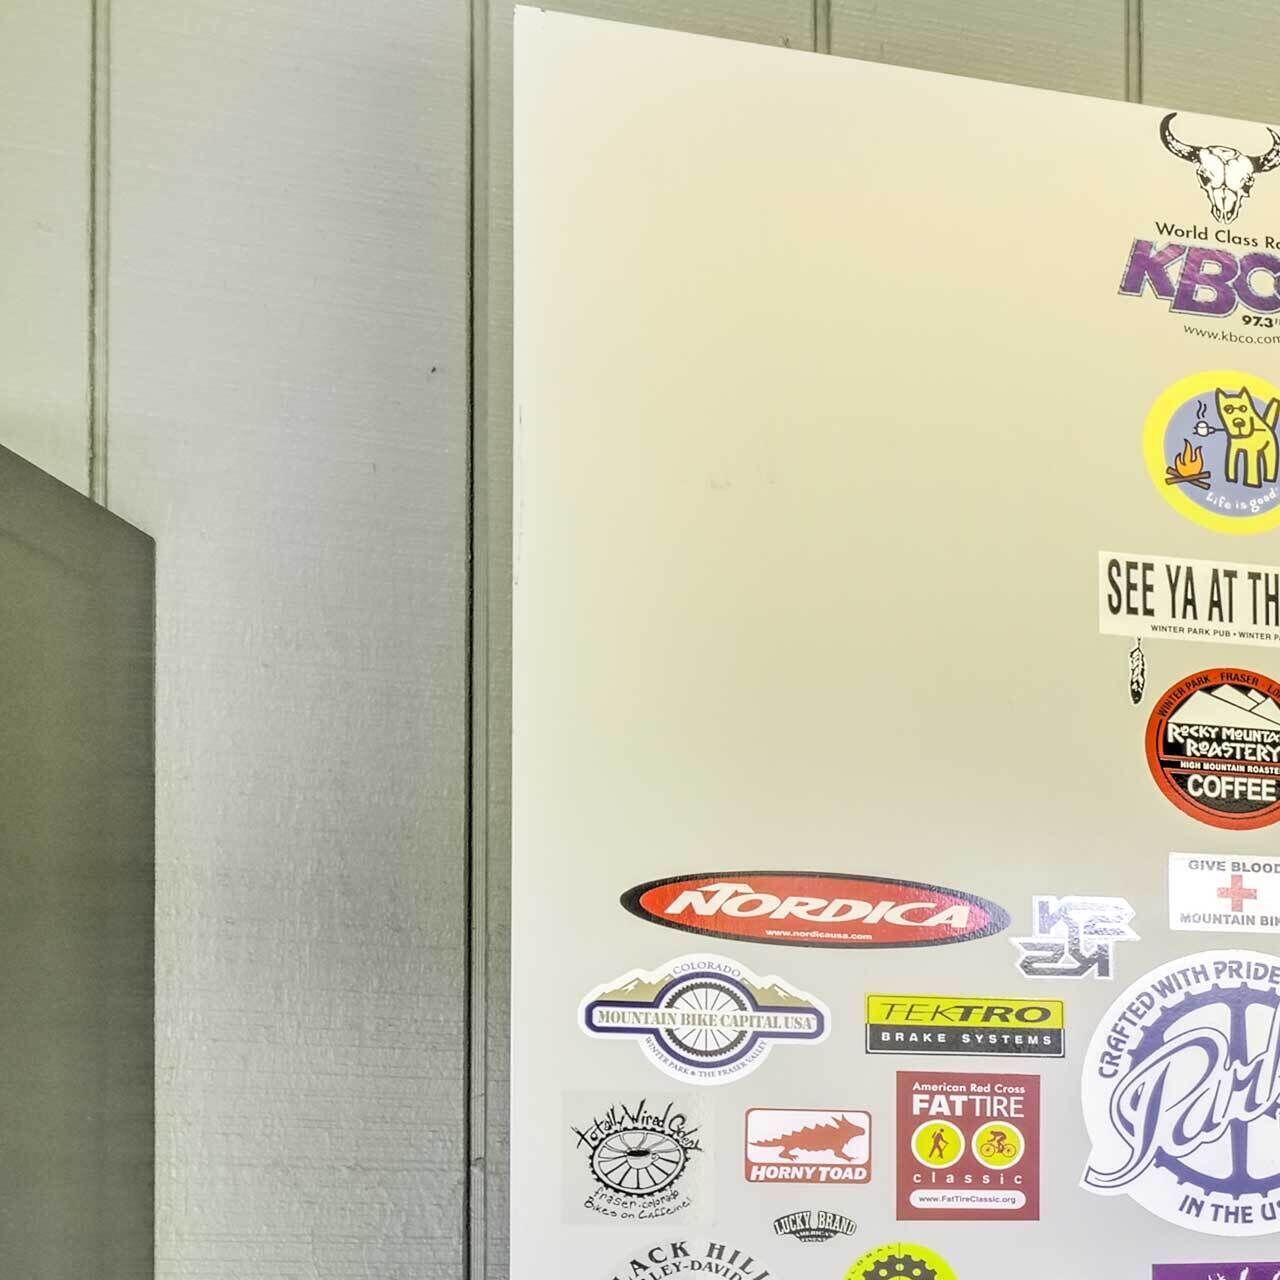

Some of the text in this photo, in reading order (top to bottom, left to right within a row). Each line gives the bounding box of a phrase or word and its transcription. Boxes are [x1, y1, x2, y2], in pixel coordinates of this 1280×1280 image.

[1155, 221, 1208, 241] World
[1215, 229, 1258, 248] Class
[1242, 315, 1274, 329] 97.3
[1107, 558, 1155, 617] SEE
[1165, 564, 1198, 620] YA
[1208, 568, 1238, 623] AT
[1150, 624, 1273, 641] WINTER PARK PUB WINTER
[1220, 672, 1259, 686] FRASER
[1180, 760, 1201, 770] HIGH
[1203, 762, 1245, 773] MOUNTAIN
[1187, 774, 1277, 802] COFFEE
[1188, 859, 1227, 872] GIVE
[664, 882, 970, 928] NORDICA
[1180, 912, 1257, 926] MOUNTAIN
[765, 928, 873, 941] www.nordicausa.com
[673, 961, 741, 978] COLORADO
[598, 1010, 812, 1030] MOUNTAIN BIKE CAPITAL USA
[880, 1002, 1051, 1023] TEKTRO
[1098, 990, 1156, 1079] CRAFTED
[1152, 965, 1210, 997] WITH
[881, 1032, 1052, 1046] BRAKE SYSTEMS
[645, 1036, 768, 1077] WINTER FRASER VALLEY
[912, 1081, 1026, 1094] American Red Cross
[750, 1165, 867, 1182] HORNY TOAD
[913, 1172, 1023, 1186] classic
[1177, 1195, 1205, 1218] IN
[1210, 1203, 1254, 1224] THE
[774, 1211, 811, 1236] LUCKY
[818, 1211, 857, 1236] BRAND
